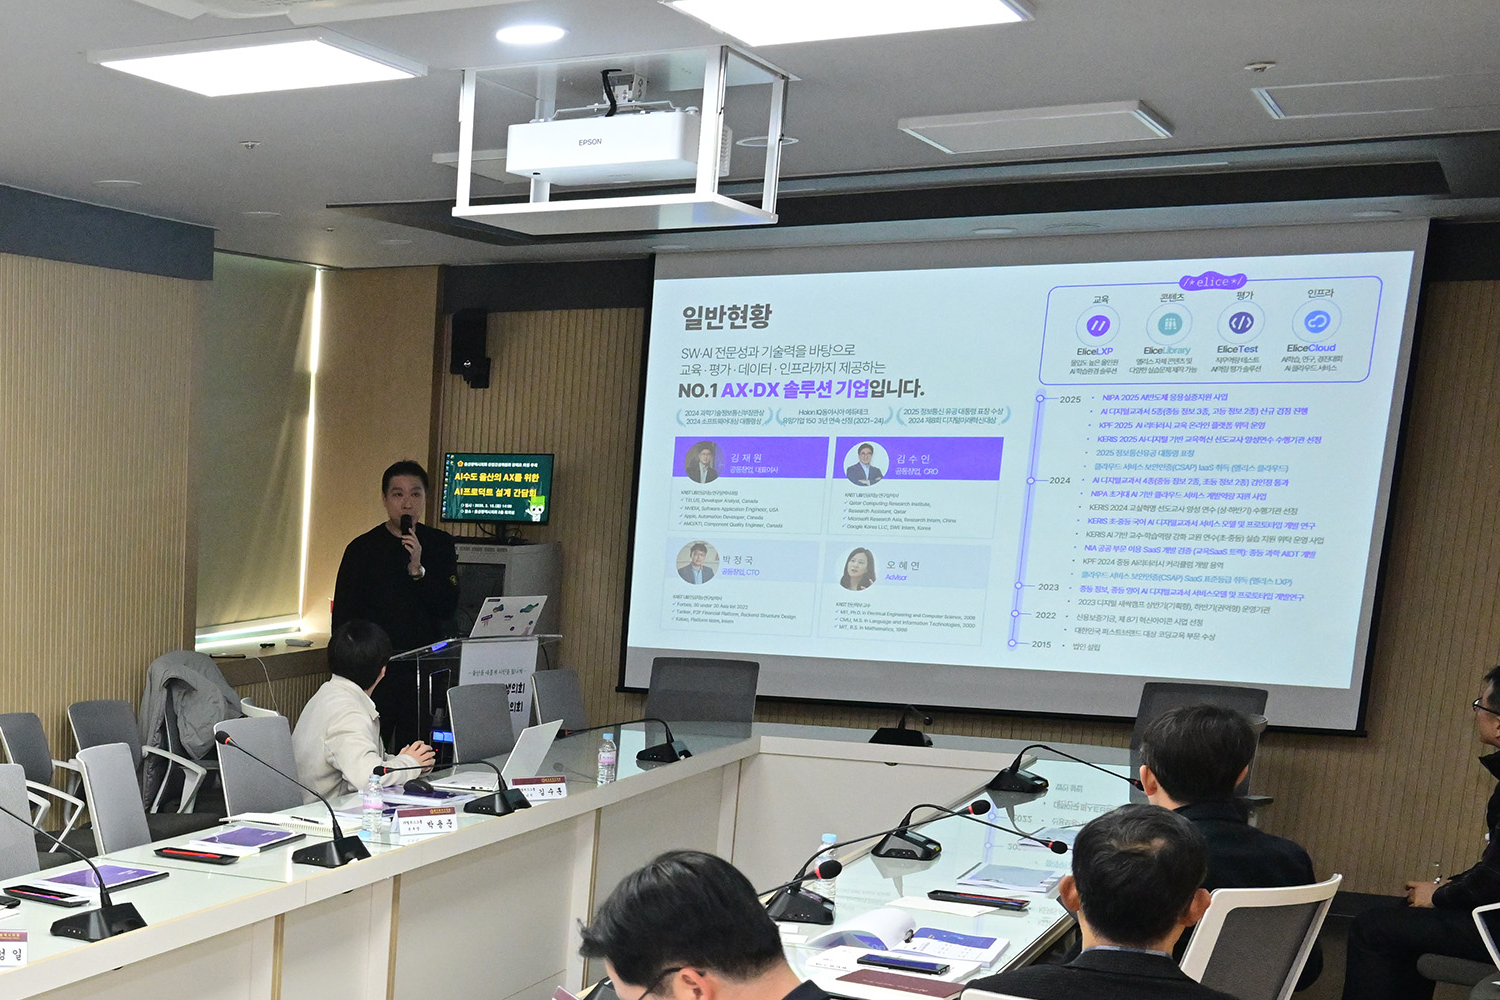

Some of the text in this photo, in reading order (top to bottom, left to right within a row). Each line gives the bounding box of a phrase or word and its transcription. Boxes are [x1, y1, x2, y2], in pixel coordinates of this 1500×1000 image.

[579, 138, 602, 146] EPSON
[1093, 288, 1334, 304] 교육 콘텐츠 평가 인프라
[683, 304, 772, 330] 일반현황
[681, 344, 855, 359] SW·AI 전문성과 기술력을 바탕으로
[1077, 347, 1113, 355] EliceLXP
[1217, 345, 1258, 353] EliceTest
[1287, 344, 1336, 352] EliceCloud
[680, 361, 886, 376] 교육 평가 데이터 인프라까지 제공하는
[678, 379, 925, 399] NO.1 AX·DX 솔루션 기업입니다.
[1214, 393, 1228, 401] 사업
[454, 473, 478, 481] AI수도
[479, 473, 502, 482] 울산의
[524, 473, 539, 482] 위한
